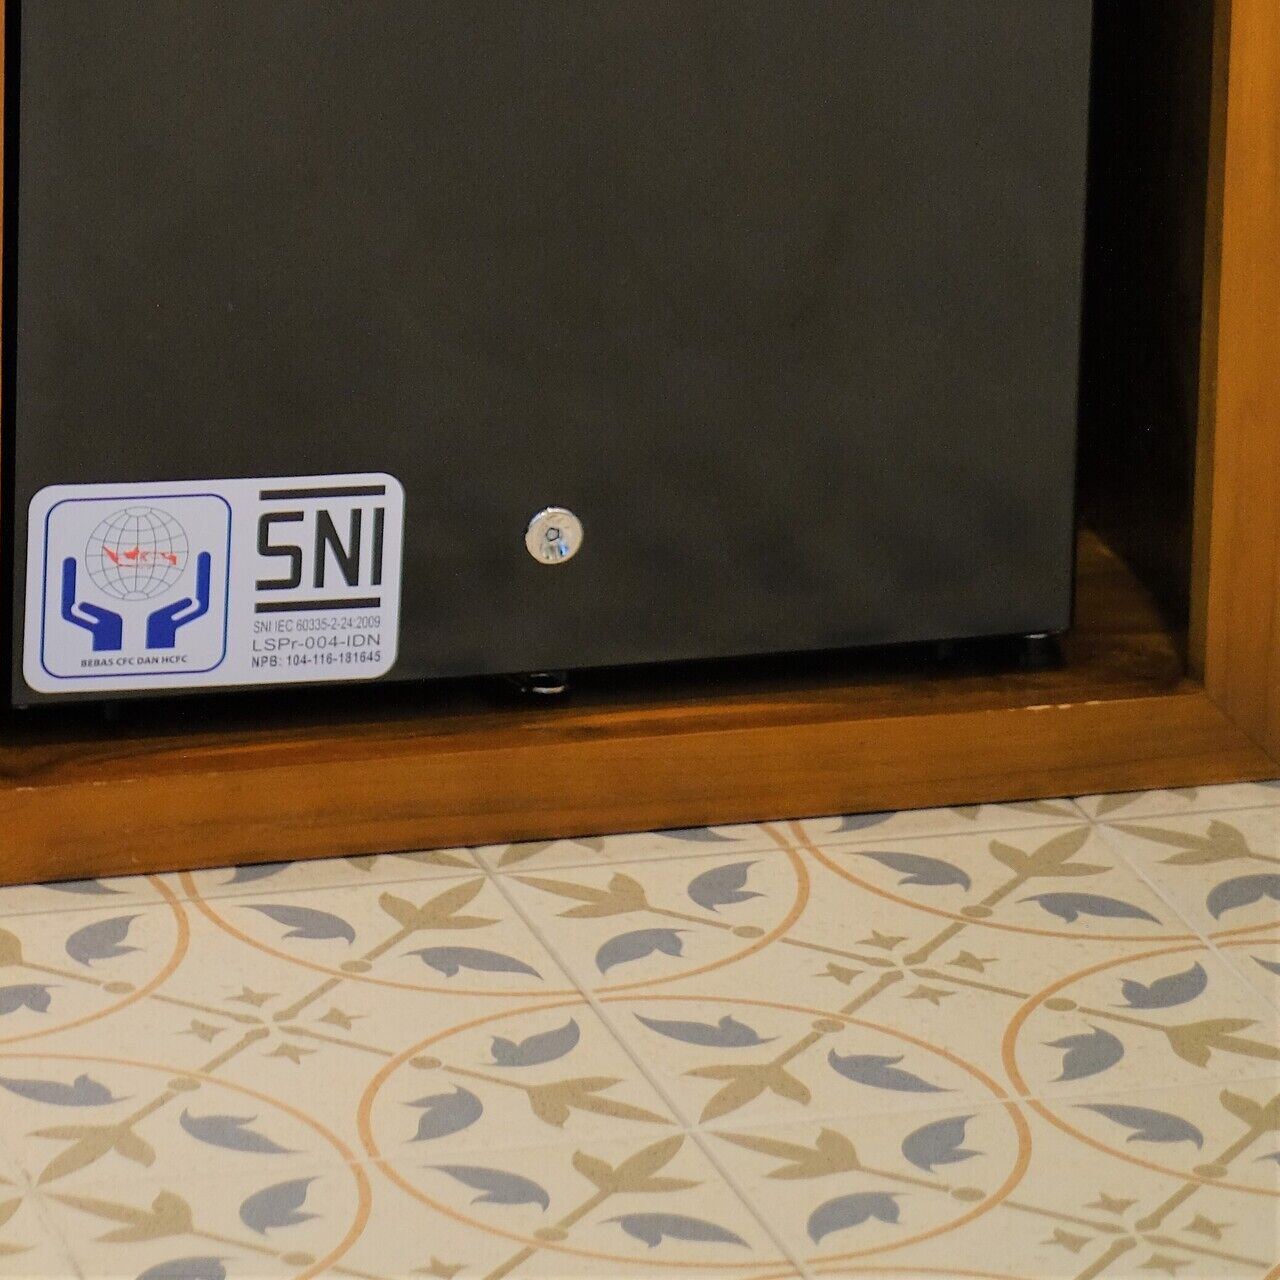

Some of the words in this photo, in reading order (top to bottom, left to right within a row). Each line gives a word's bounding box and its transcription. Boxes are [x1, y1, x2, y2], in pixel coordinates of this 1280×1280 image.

[255, 506, 385, 591] SNI
[254, 620, 272, 633] SNI
[274, 619, 293, 632] IEC
[252, 634, 380, 652] LSPr-004-IDN
[80, 658, 113, 668] BEBAS
[116, 657, 134, 666] CFC
[137, 656, 159, 665] DAN
[161, 654, 187, 664] HCFC
[252, 655, 281, 668] NPB:
[287, 650, 381, 666] 104-116-181645
